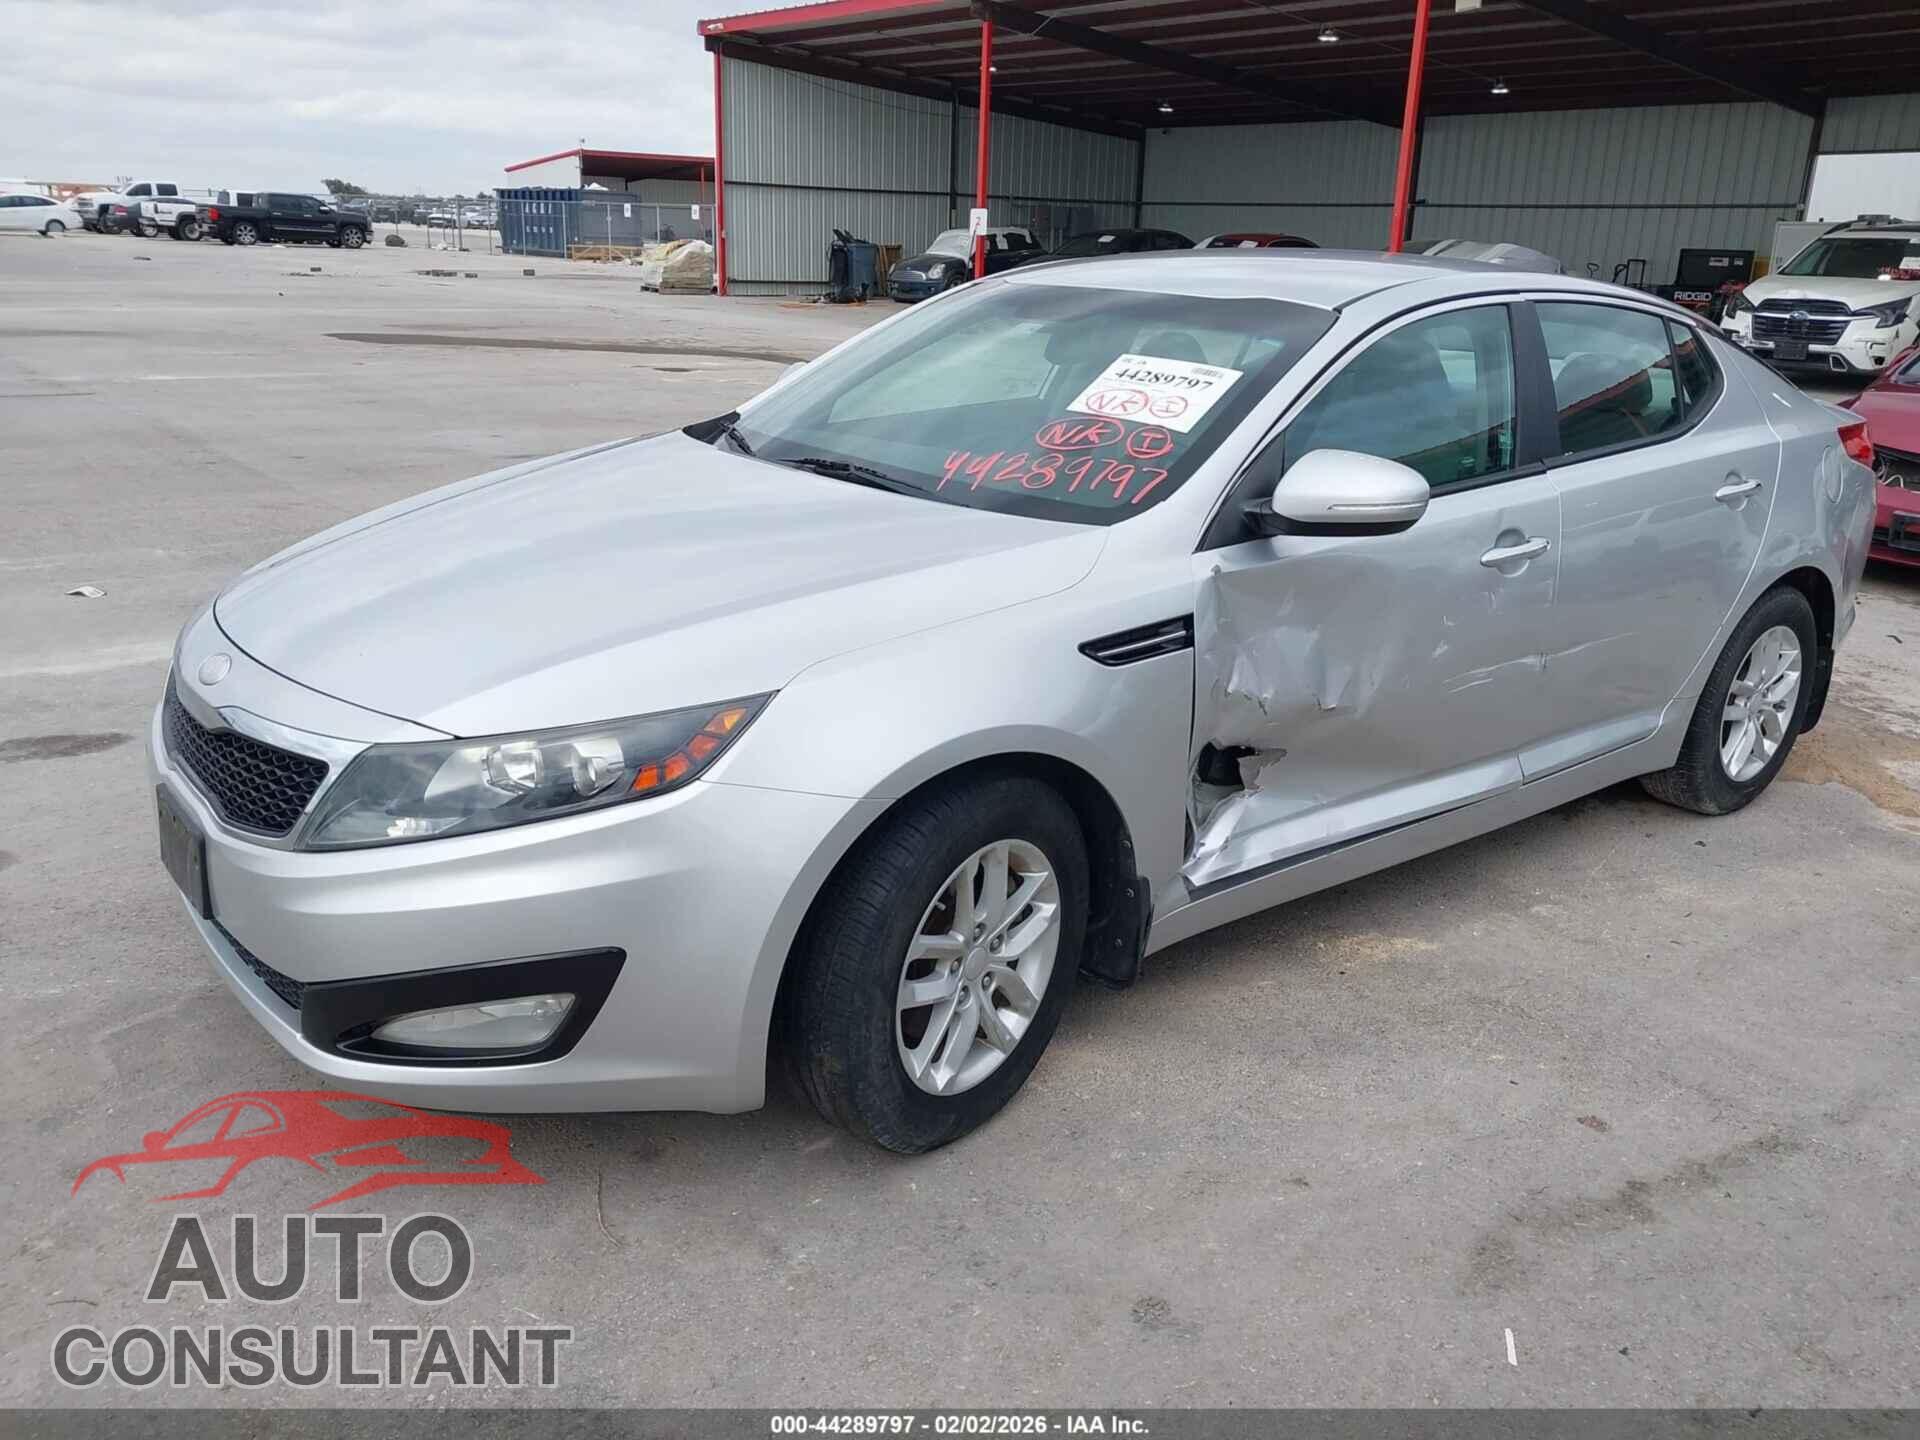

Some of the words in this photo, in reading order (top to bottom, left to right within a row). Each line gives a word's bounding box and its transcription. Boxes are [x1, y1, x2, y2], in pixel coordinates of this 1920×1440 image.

[1674, 291, 1712, 301] RIDGID
[1115, 368, 1213, 392] 44289797
[936, 451, 1168, 504] 44289797
